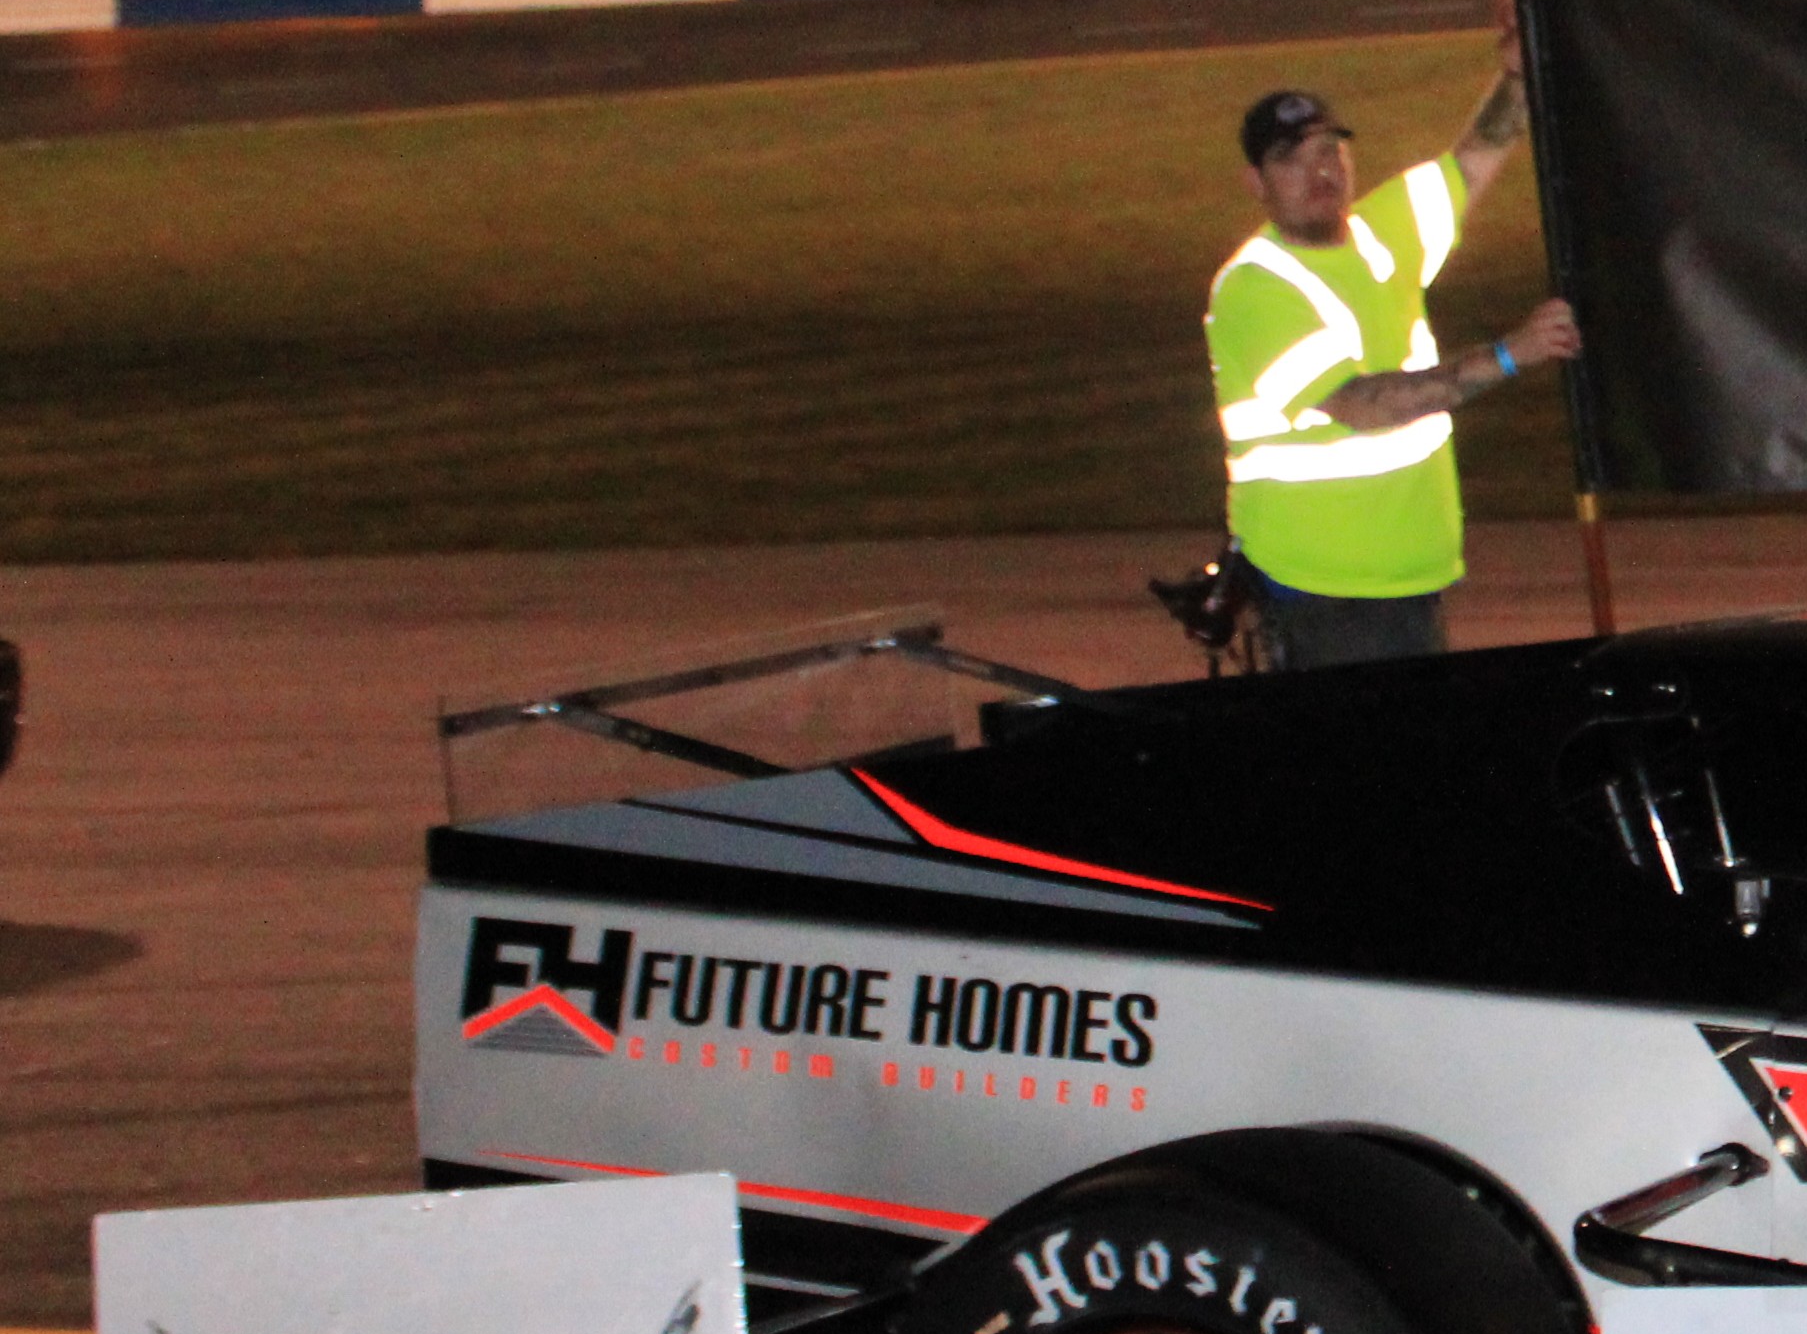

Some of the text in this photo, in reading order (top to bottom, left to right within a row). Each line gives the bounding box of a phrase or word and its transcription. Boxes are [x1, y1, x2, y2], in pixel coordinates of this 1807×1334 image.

[634, 952, 1157, 1068] FUTURE HOMES
[628, 1036, 1147, 1111] CUSTOM BUILDERS
